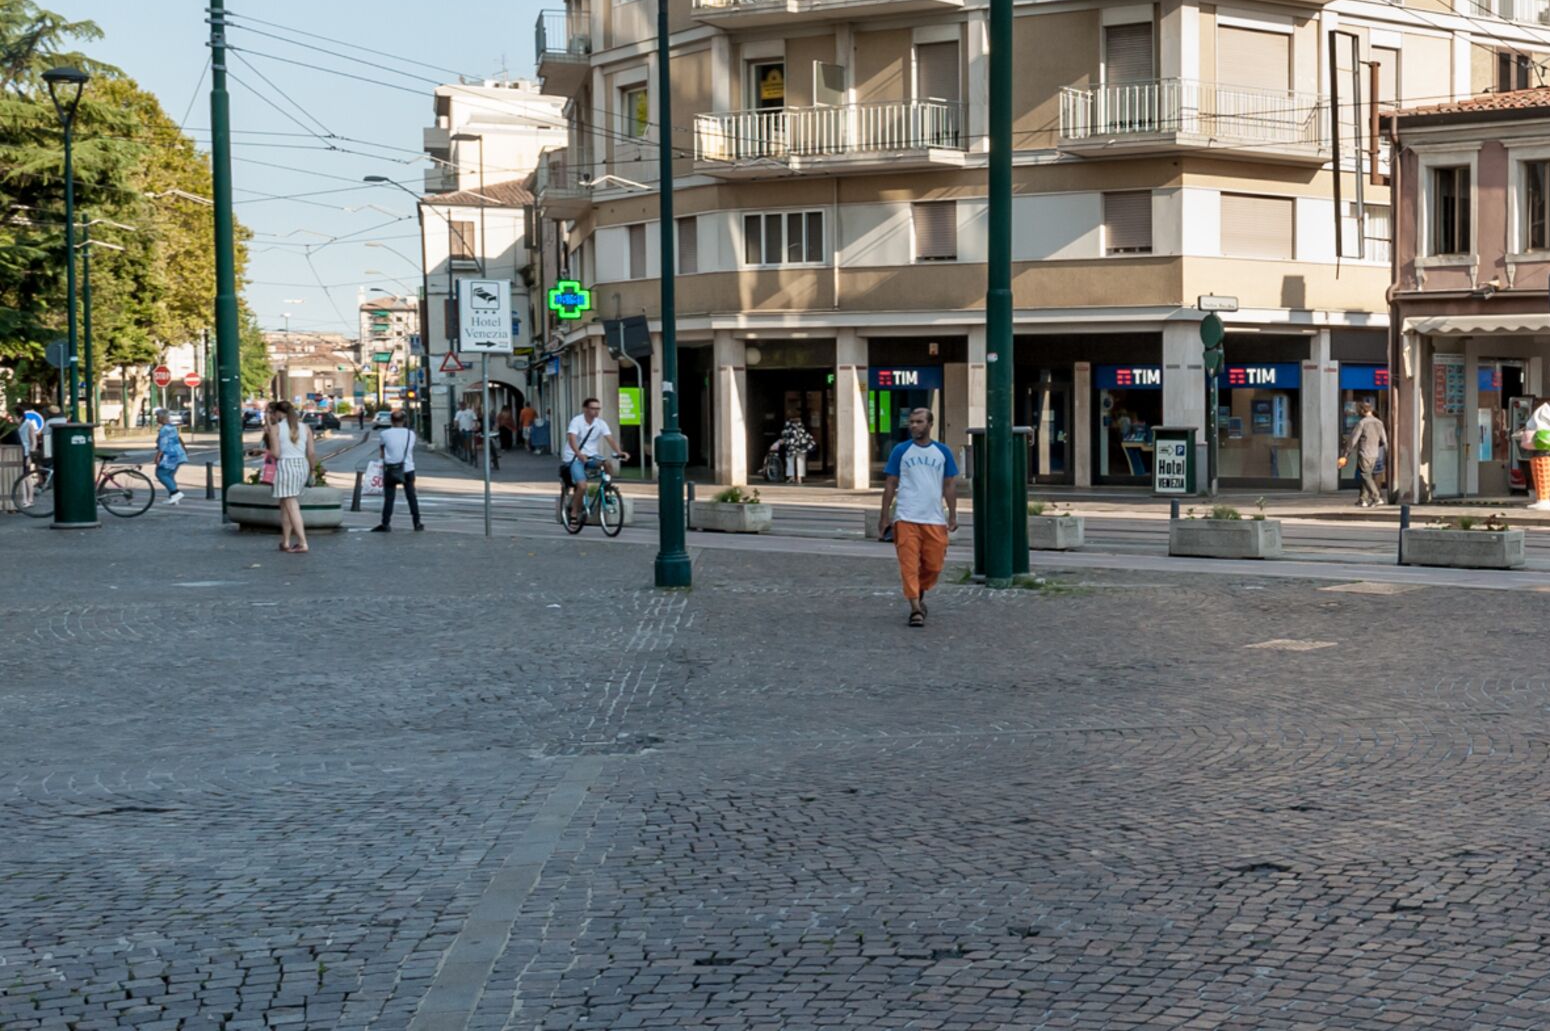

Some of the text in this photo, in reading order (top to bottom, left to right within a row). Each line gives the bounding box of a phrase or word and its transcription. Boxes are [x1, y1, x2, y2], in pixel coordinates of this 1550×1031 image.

[471, 316, 501, 327] Hotel
[465, 328, 508, 339] Venezia
[893, 370, 918, 386] TIM
[1133, 369, 1161, 385] TIM
[1246, 368, 1276, 384] TIM
[904, 456, 943, 472] ITALIA
[1158, 459, 1185, 475] Hotel
[1158, 478, 1185, 488] VENEZIA
